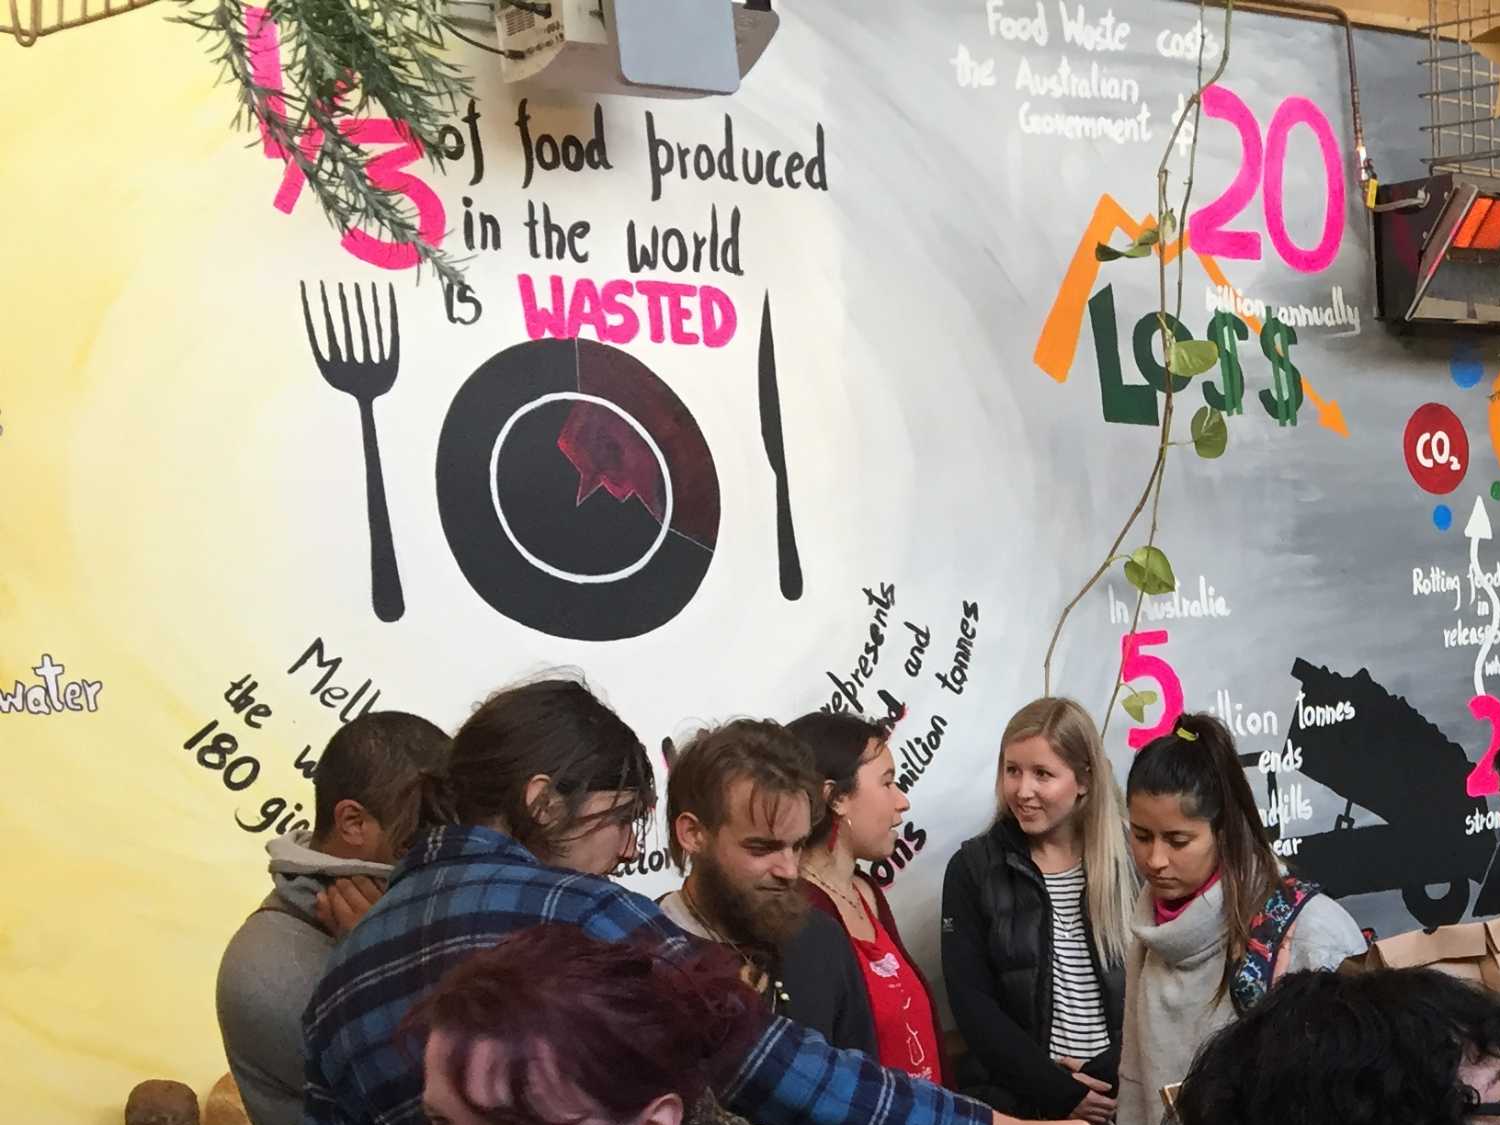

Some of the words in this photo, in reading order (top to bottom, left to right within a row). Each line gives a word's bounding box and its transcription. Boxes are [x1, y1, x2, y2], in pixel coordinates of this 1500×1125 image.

[986, 0, 1049, 46] Food
[1059, 1, 1131, 51] Waste
[1156, 20, 1220, 59] costs
[951, 44, 996, 88] the
[1015, 55, 1139, 104] Australian
[437, 98, 484, 186] of
[514, 97, 613, 189] food
[645, 110, 829, 202] produced
[1189, 82, 1345, 273] 20
[462, 196, 501, 251] in
[524, 199, 591, 263] the
[627, 203, 744, 276] world
[517, 273, 738, 349] WASTED
[1205, 285, 1267, 319] billion
[1278, 286, 1361, 337] annually
[1108, 583, 1129, 624] In
[1412, 566, 1462, 612] Rotting
[1477, 595, 1490, 616] in
[903, 620, 931, 678] and
[935, 599, 979, 695] tonnes
[0, 653, 102, 714] water
[224, 674, 272, 729] the
[1119, 629, 1185, 752] 5
[1296, 691, 1356, 730] tonnes
[183, 719, 260, 792] 180
[1258, 739, 1304, 774] ends
